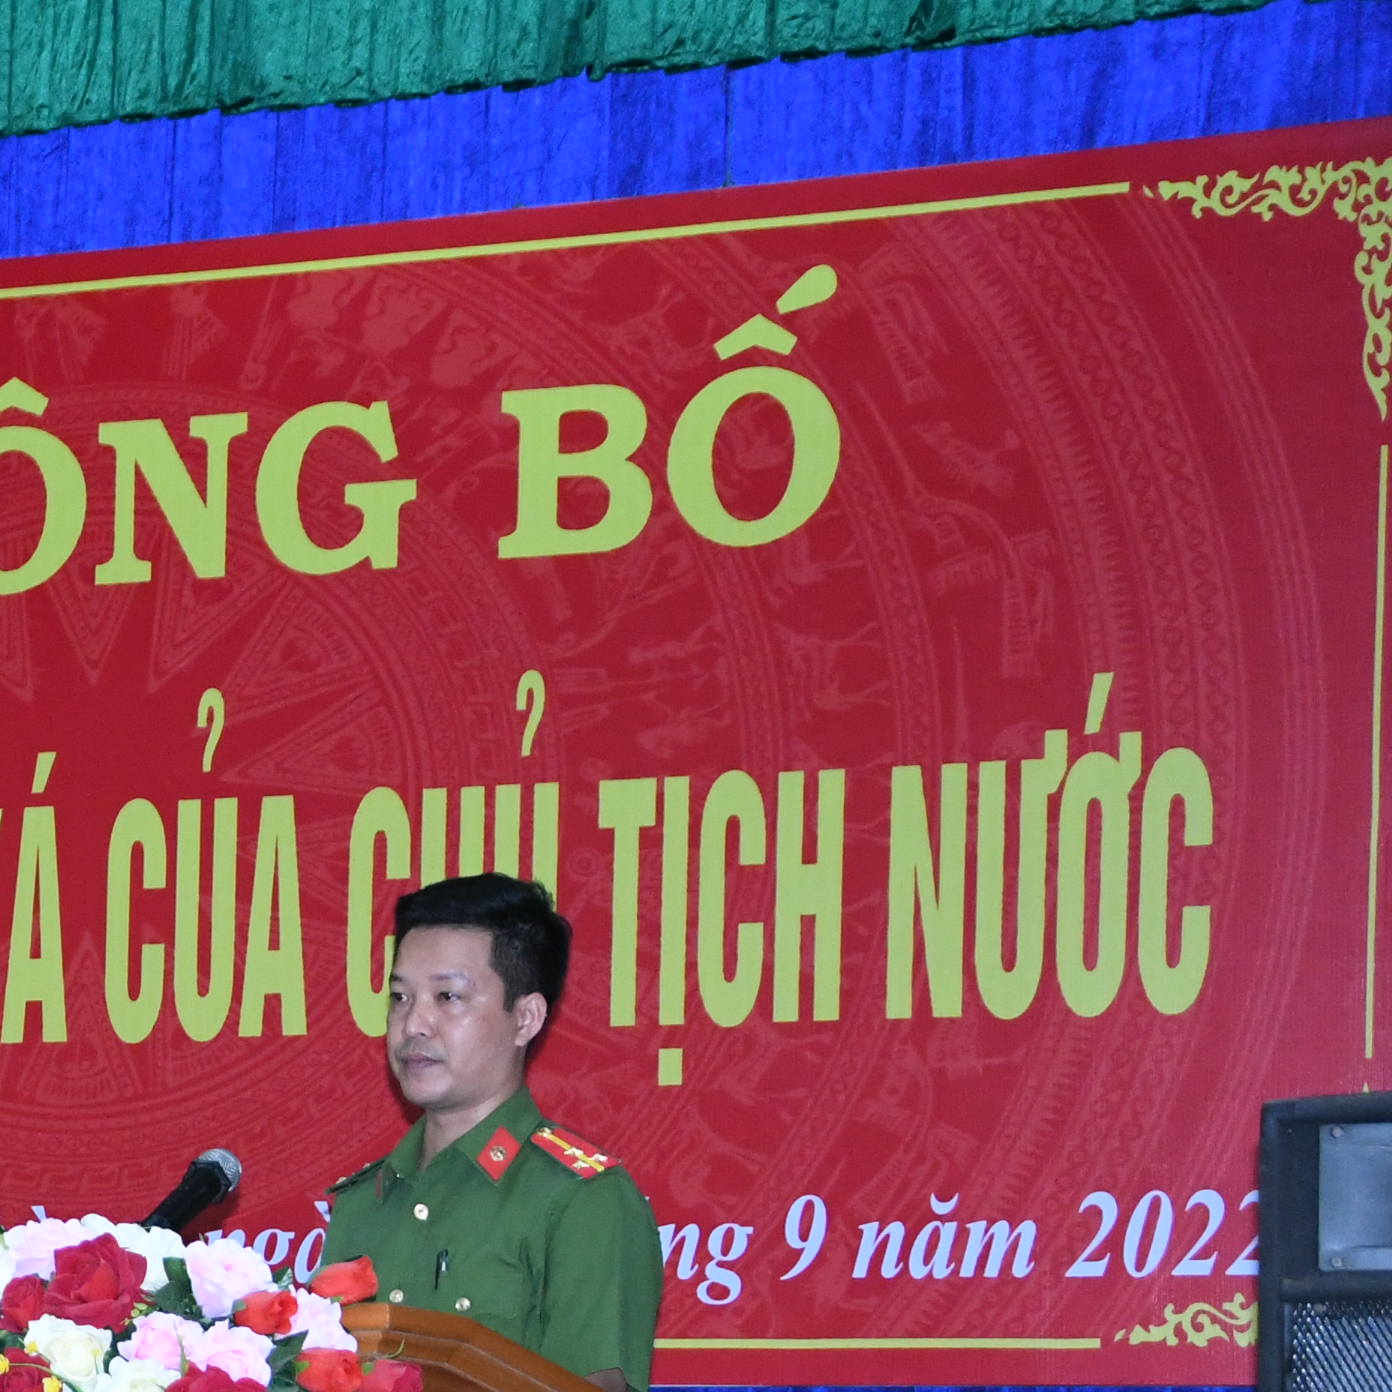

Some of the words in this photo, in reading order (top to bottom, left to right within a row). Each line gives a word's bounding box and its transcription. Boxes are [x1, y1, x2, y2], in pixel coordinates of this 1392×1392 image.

[498, 264, 841, 559] BỐ
[105, 688, 308, 1044] CỦA
[598, 768, 846, 1087] TỊCH
[886, 672, 1214, 1020] NƯỚC
[779, 1194, 828, 1281] 9
[852, 1192, 1037, 1280] năm
